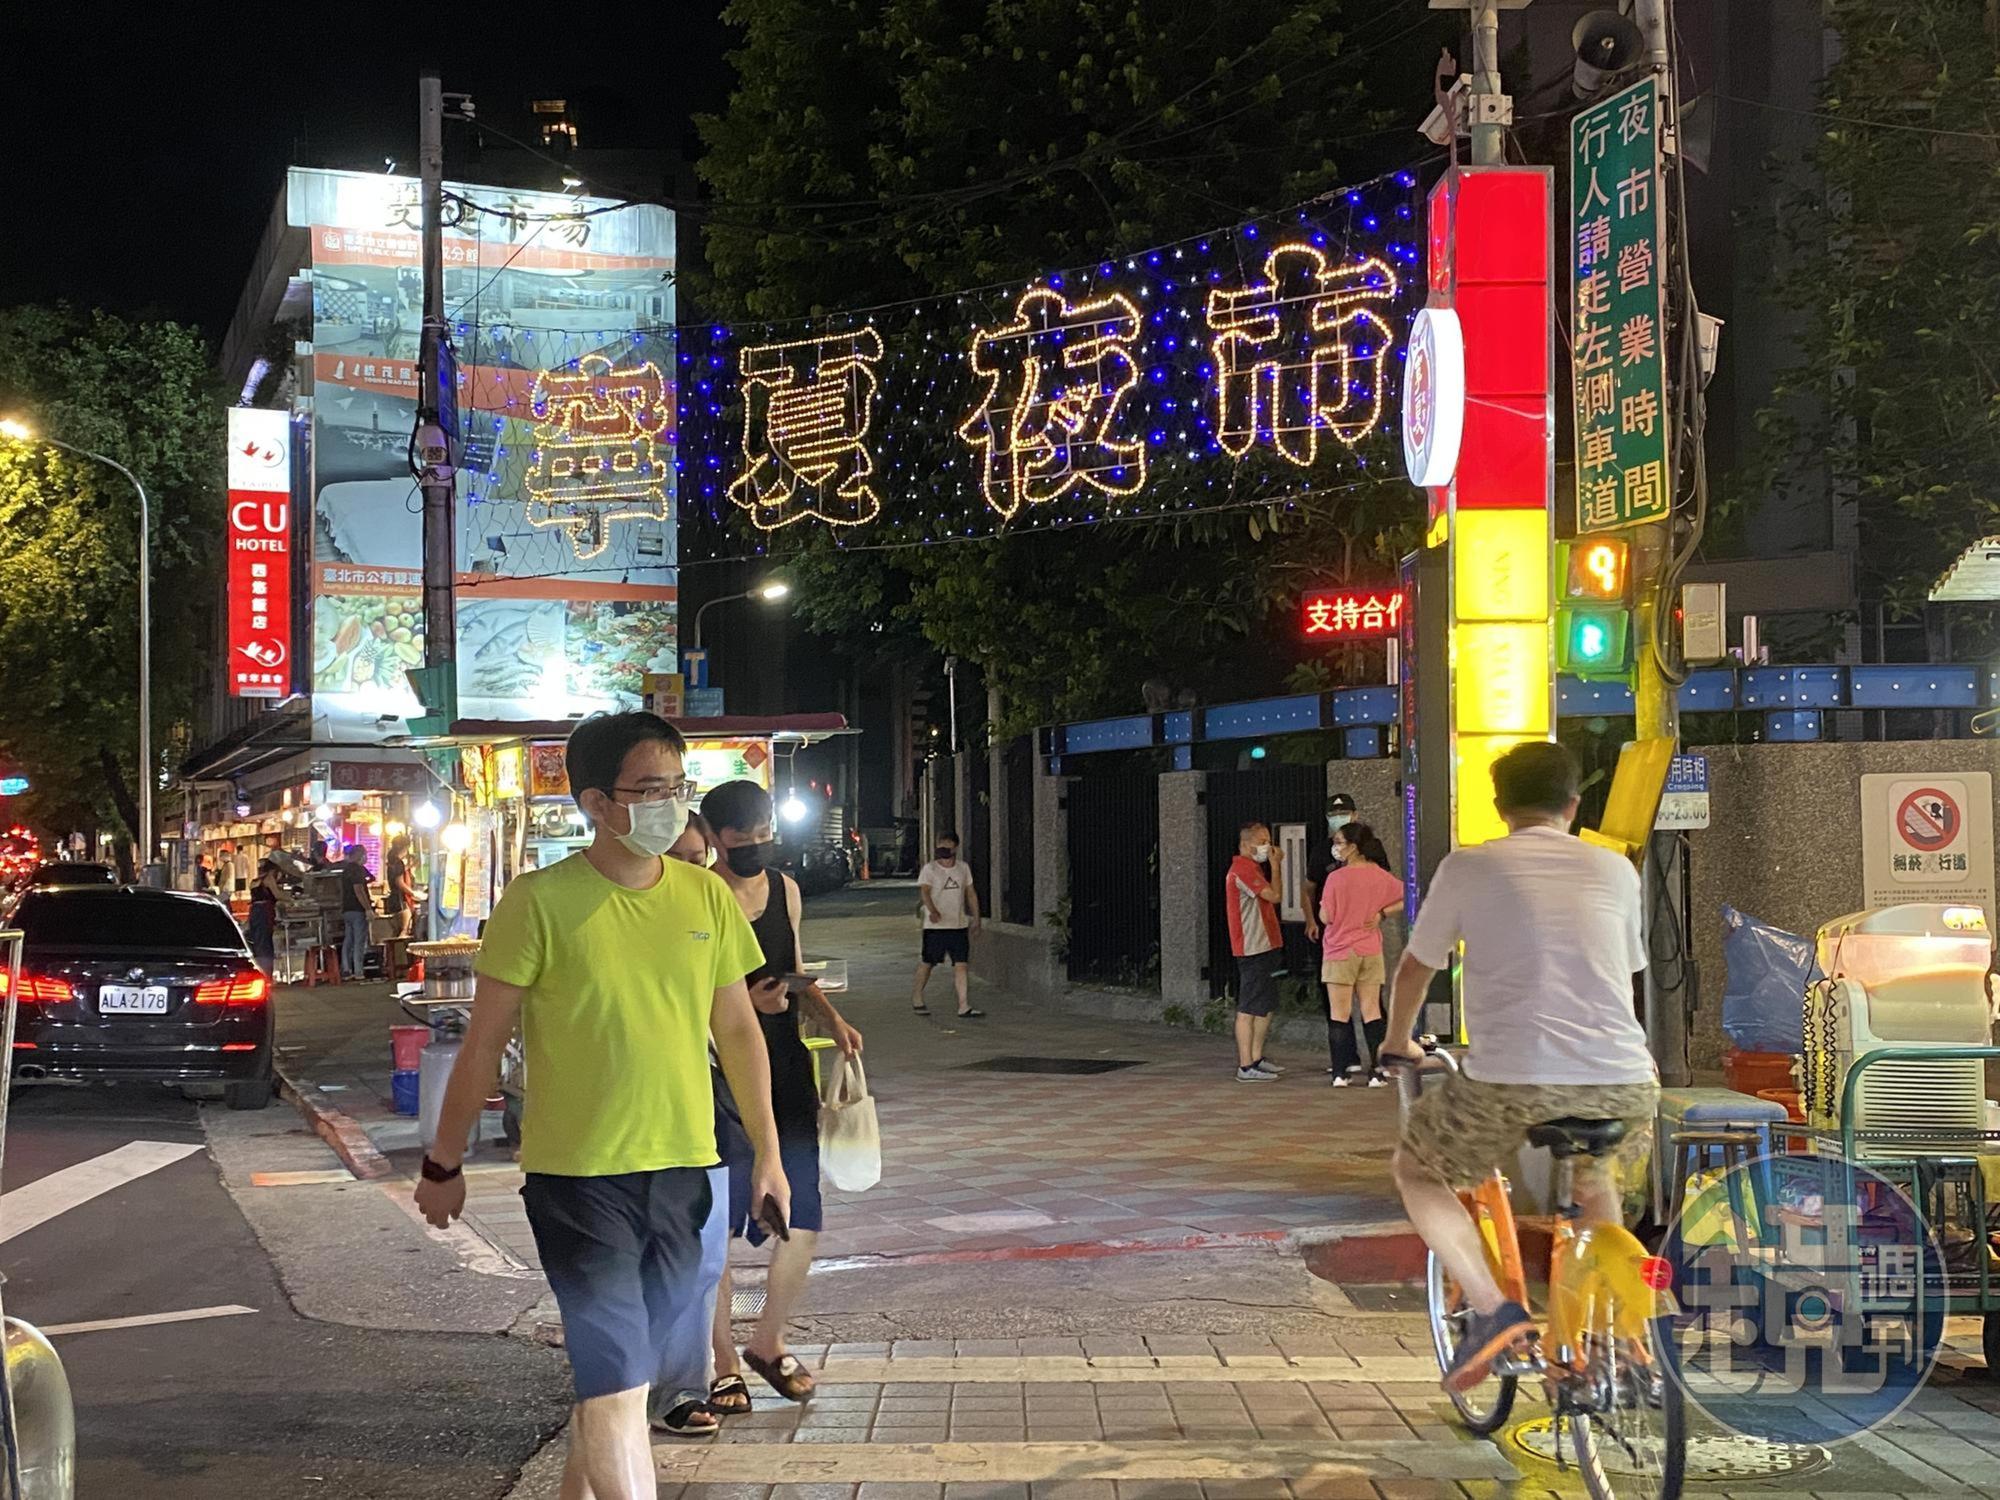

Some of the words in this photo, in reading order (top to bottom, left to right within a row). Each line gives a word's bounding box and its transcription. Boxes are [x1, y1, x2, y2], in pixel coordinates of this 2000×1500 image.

[1577, 115, 1619, 526] 行人請走左側車道
[1616, 91, 1663, 518] 夜市營業時間
[231, 501, 287, 533] CU
[235, 538, 287, 552] HOTEL
[1588, 545, 1616, 592] 9
[1668, 757, 1705, 782] 用時相
